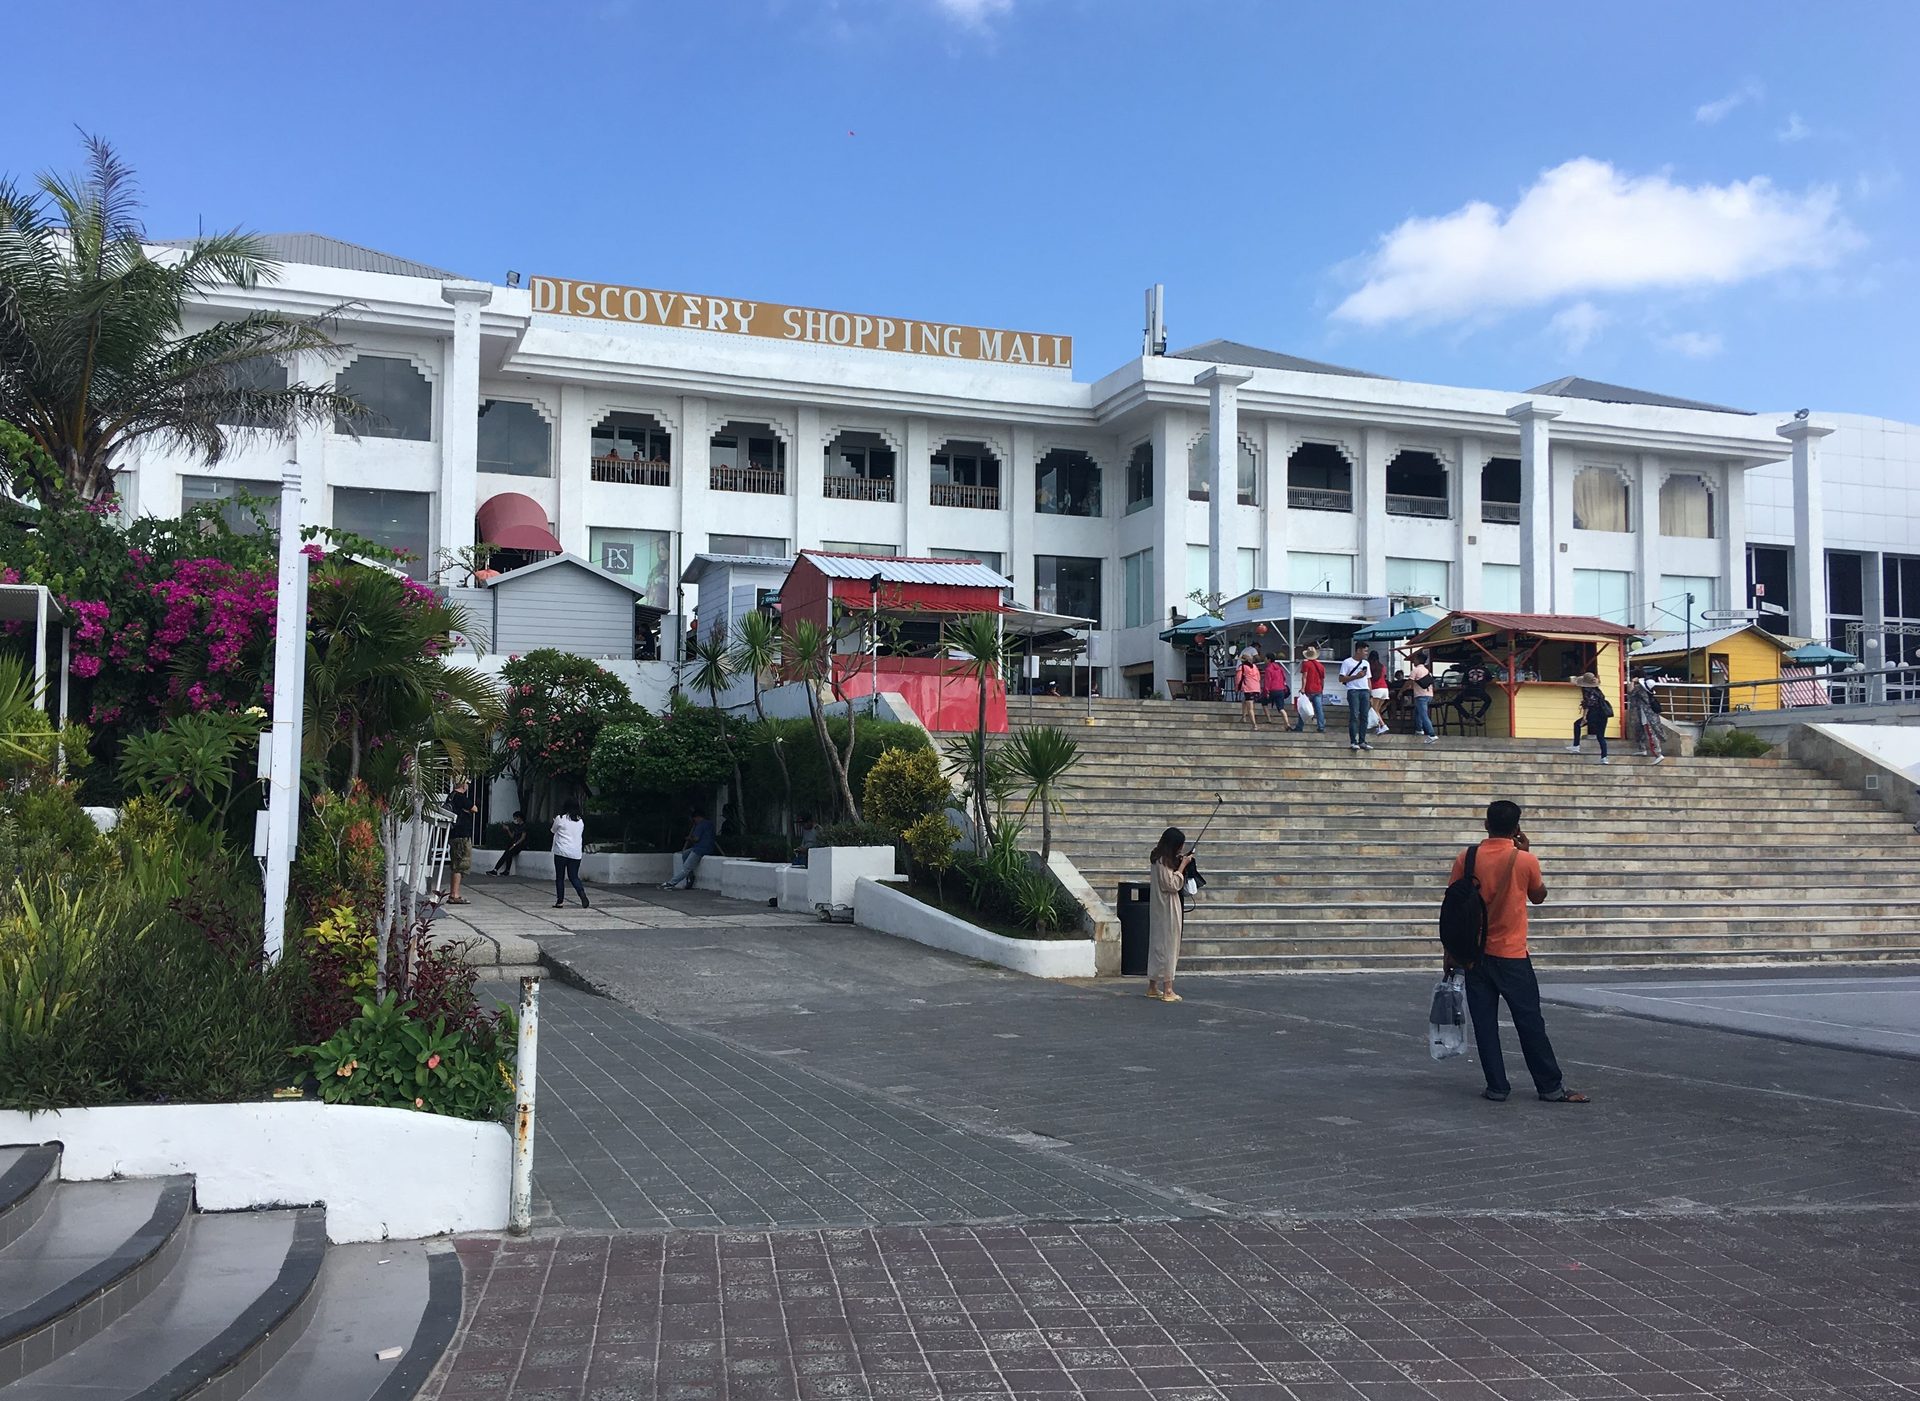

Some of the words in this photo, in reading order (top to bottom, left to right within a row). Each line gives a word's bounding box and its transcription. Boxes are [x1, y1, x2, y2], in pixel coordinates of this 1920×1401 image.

[532, 278, 757, 334] DISCOVERY
[783, 308, 962, 357] SHOPPING
[977, 329, 1070, 368] MALL
